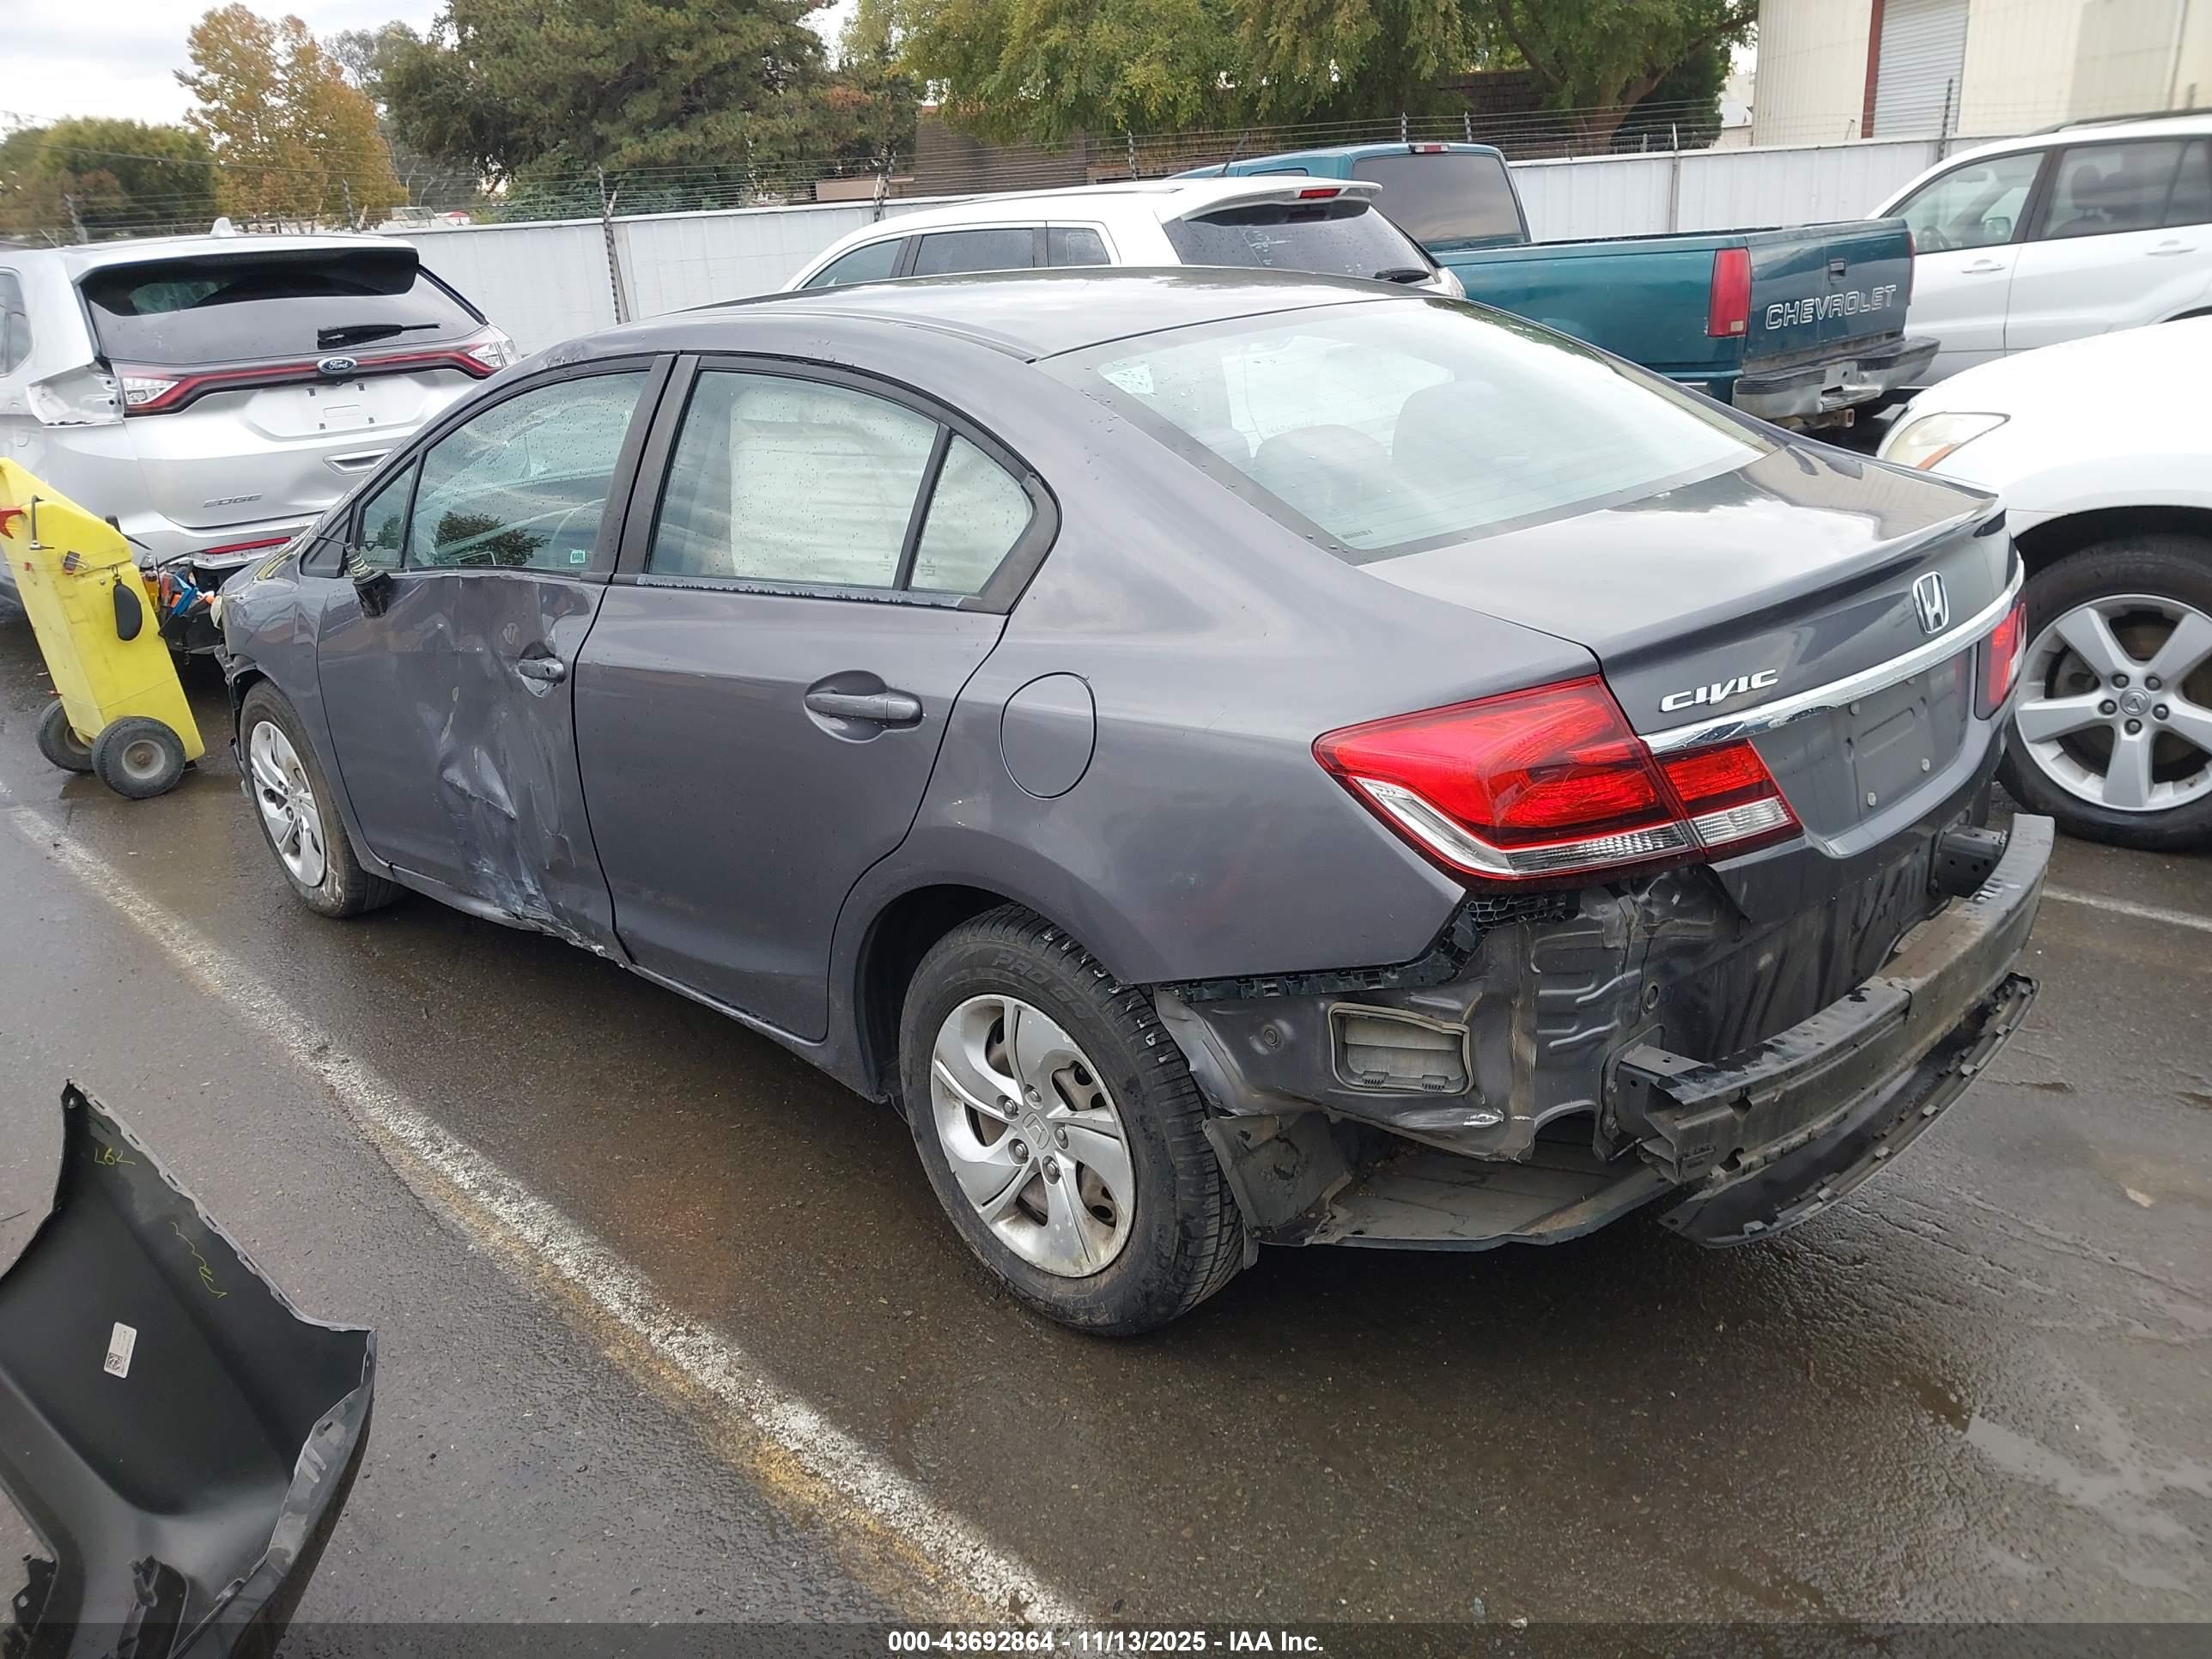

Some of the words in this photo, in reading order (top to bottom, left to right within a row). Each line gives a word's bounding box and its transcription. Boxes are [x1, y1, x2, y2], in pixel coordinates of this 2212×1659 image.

[1765, 284, 1897, 330] CHEVROLET
[328, 359, 349, 370] Ford
[204, 493, 262, 507] EDGE
[1660, 668, 1780, 712] CIVIC
